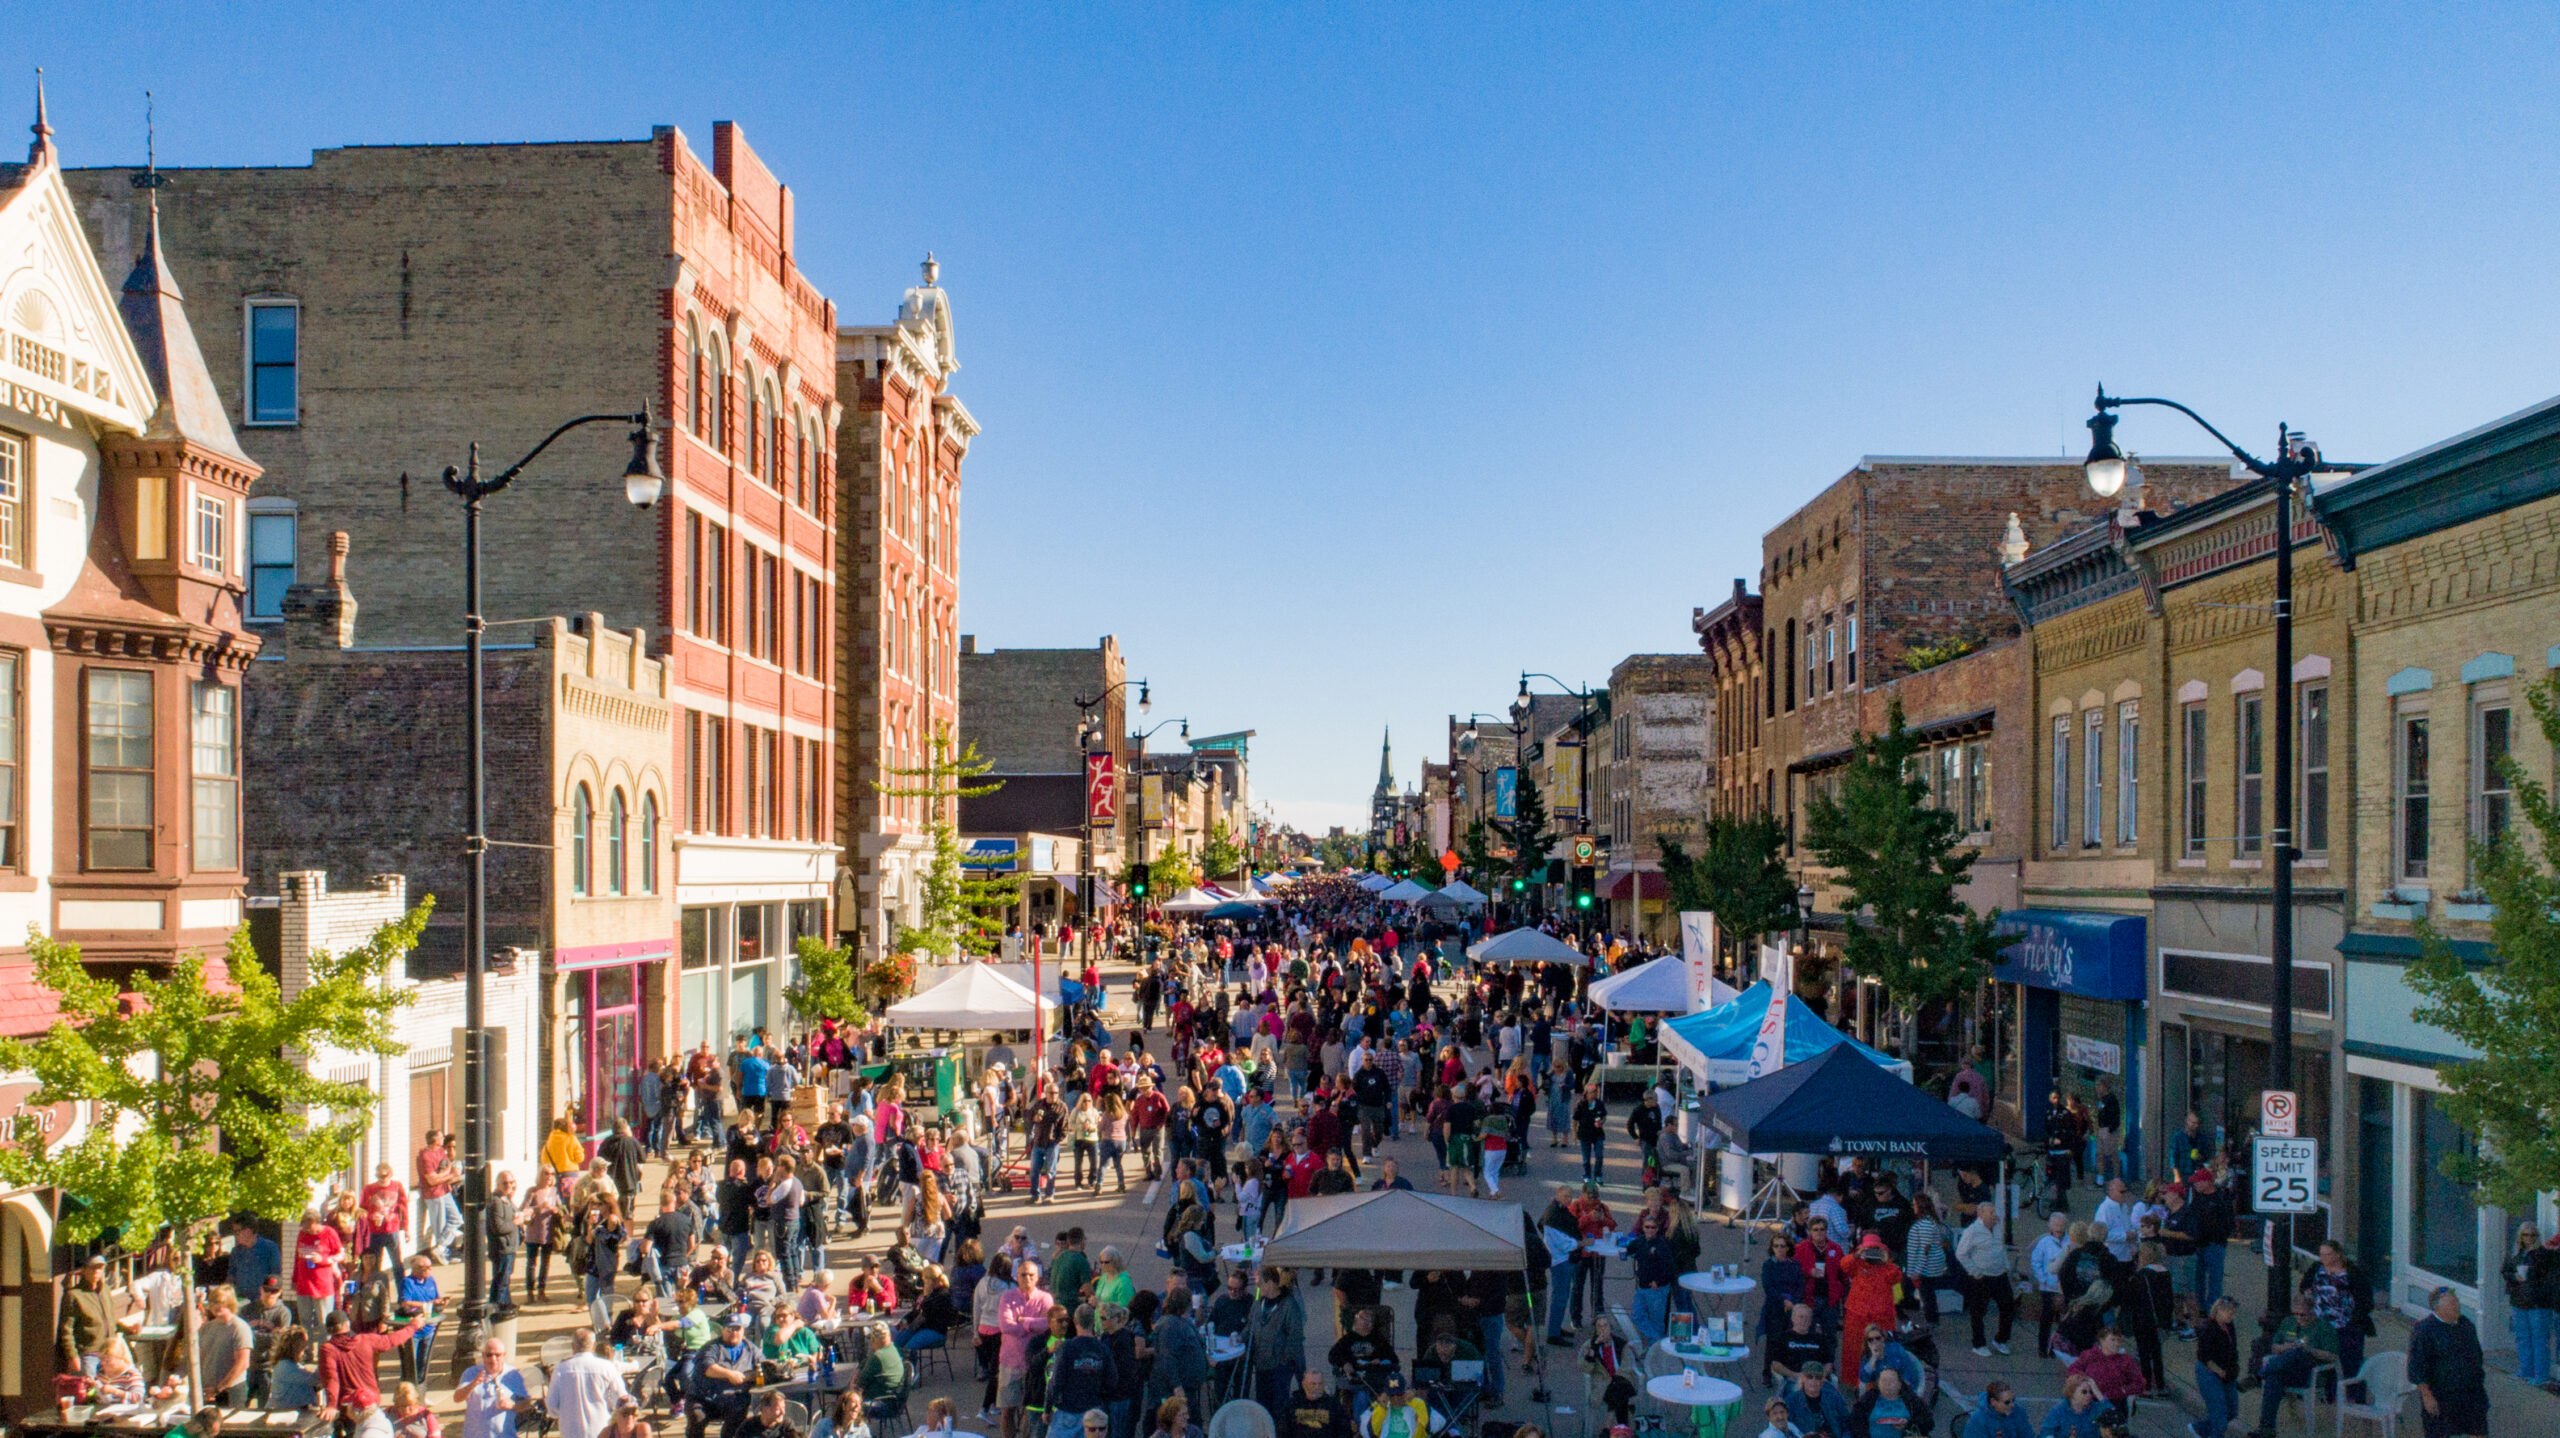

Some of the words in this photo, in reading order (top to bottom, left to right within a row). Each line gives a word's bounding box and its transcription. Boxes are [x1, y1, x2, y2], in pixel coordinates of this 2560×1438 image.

[2024, 928, 2074, 986] ricky's
[2265, 1119, 2293, 1127] ANYTIME
[1845, 1141, 1887, 1151] TOWN
[1890, 1141, 1928, 1155] BANK
[2261, 1147, 2310, 1158] SPEED
[2265, 1162, 2304, 1173] LIMIT
[2261, 1177, 2309, 1203] 25
